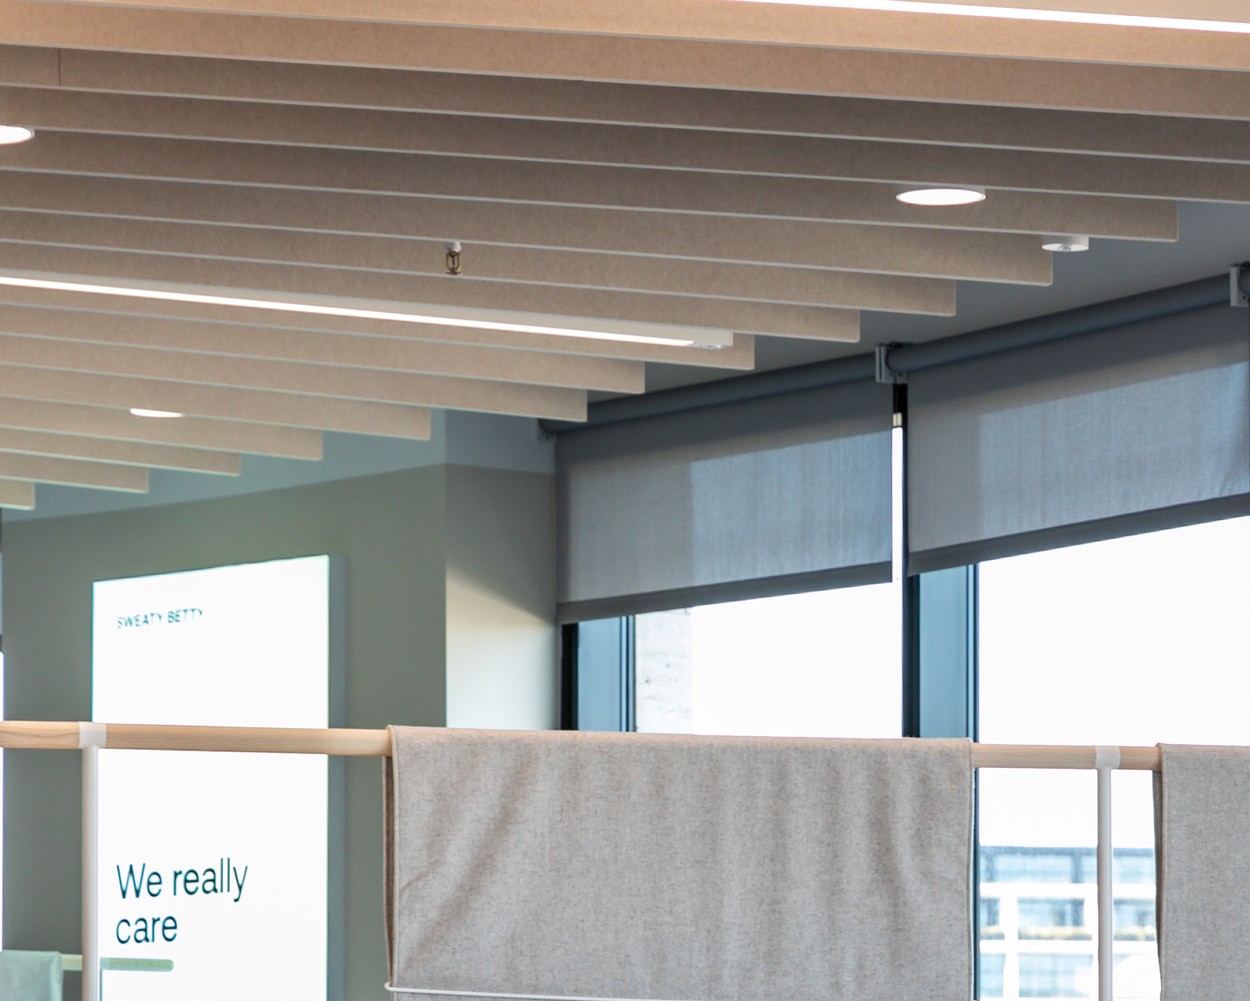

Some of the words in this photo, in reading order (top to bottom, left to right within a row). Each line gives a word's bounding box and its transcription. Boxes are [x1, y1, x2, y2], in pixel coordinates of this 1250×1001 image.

[168, 608, 203, 624] BETTY
[116, 863, 163, 899] We
[173, 857, 248, 903] really
[116, 915, 178, 944] care
